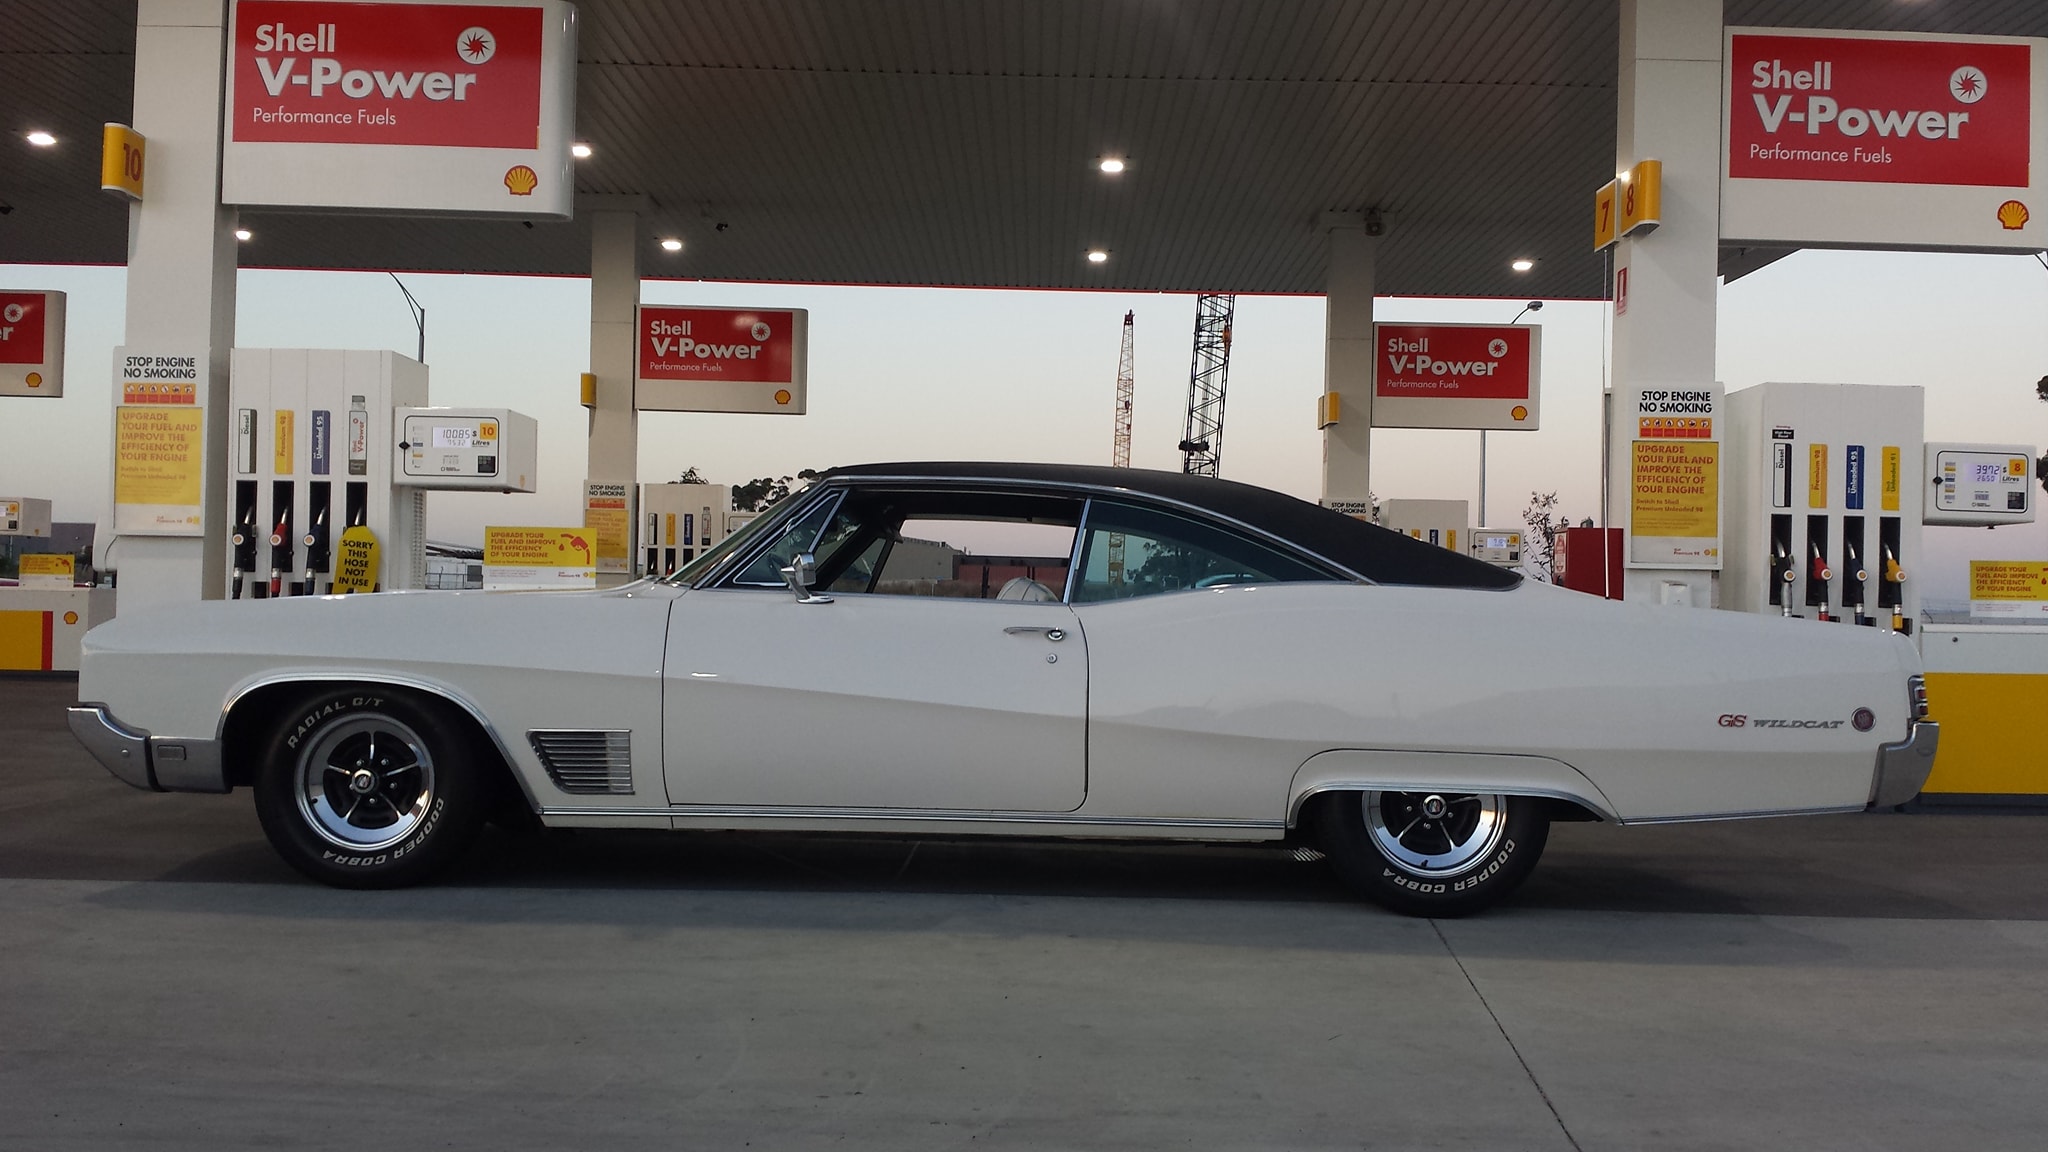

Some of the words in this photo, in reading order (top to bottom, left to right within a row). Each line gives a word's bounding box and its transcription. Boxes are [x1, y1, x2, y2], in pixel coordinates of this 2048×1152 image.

[254, 22, 336, 53] Shell
[254, 57, 477, 101] V-Power
[1752, 58, 1832, 90] Shell
[253, 106, 353, 125] Performance
[357, 108, 397, 126] Fuels
[1752, 93, 1970, 140] V-Power
[1750, 142, 1849, 162] Performance
[1854, 146, 1893, 164] Fuels
[123, 142, 142, 182] 10
[1626, 183, 1634, 217] 8
[1602, 199, 1610, 233] 7
[650, 319, 692, 336] Shell
[650, 336, 762, 360] V-Power
[1388, 337, 1429, 353] Shell
[126, 357, 153, 367] STOP
[155, 357, 195, 368] ENGINE
[650, 361, 700, 372] Performance
[702, 362, 723, 373] Fuels
[1388, 354, 1499, 376] V-Power
[124, 367, 142, 379] NO
[144, 368, 197, 379] SMOKING
[1387, 379, 1437, 390] Performance
[1439, 380, 1459, 390] Fuels
[1641, 390, 1669, 401] STOP
[1671, 391, 1711, 402] ENGINE
[1639, 402, 1657, 413] NO
[1659, 402, 1713, 414] SMOKING
[122, 412, 169, 421] UPGRADE
[122, 422, 149, 431] YOUR
[150, 423, 173, 431] FUEL
[175, 424, 198, 432] AND
[482, 426, 495, 436] 10
[121, 432, 165, 441] IMPROVE
[168, 433, 186, 442] THE
[121, 442, 175, 452] EFFICIENCY
[176, 443, 190, 452] OF
[1637, 445, 1685, 454] UPGRADE
[120, 452, 148, 461] YOUR
[150, 453, 188, 462] ENGINE
[1637, 455, 1664, 463] YOUR
[1666, 455, 1690, 464] FUEL
[1691, 456, 1714, 465] AND
[1637, 465, 1682, 474] IMPROVE
[1684, 466, 1702, 474] THE
[1976, 464, 2001, 475] 3972
[2014, 463, 2021, 472] 8
[1636, 475, 1691, 484] EFFICIENCY
[1692, 476, 1706, 484] OF
[1850, 461, 1858, 494] Unleaded
[1636, 485, 1663, 493] YOUR
[1666, 486, 1705, 495] ENGINE
[342, 538, 374, 550] SORRY
[347, 549, 368, 559] THIS
[344, 558, 369, 568] HOSE
[344, 567, 366, 577] NOT
[338, 577, 351, 586] IN
[352, 577, 369, 587] USE
[287, 701, 346, 749] RADIAL
[352, 697, 384, 707] G/T
[1717, 714, 1747, 728] GS
[1753, 719, 1845, 729] WILDCAT
[393, 797, 444, 860] COOPER
[322, 850, 386, 867] COBRA
[1453, 838, 1516, 892] COOPER
[1381, 867, 1446, 894] COBRA
